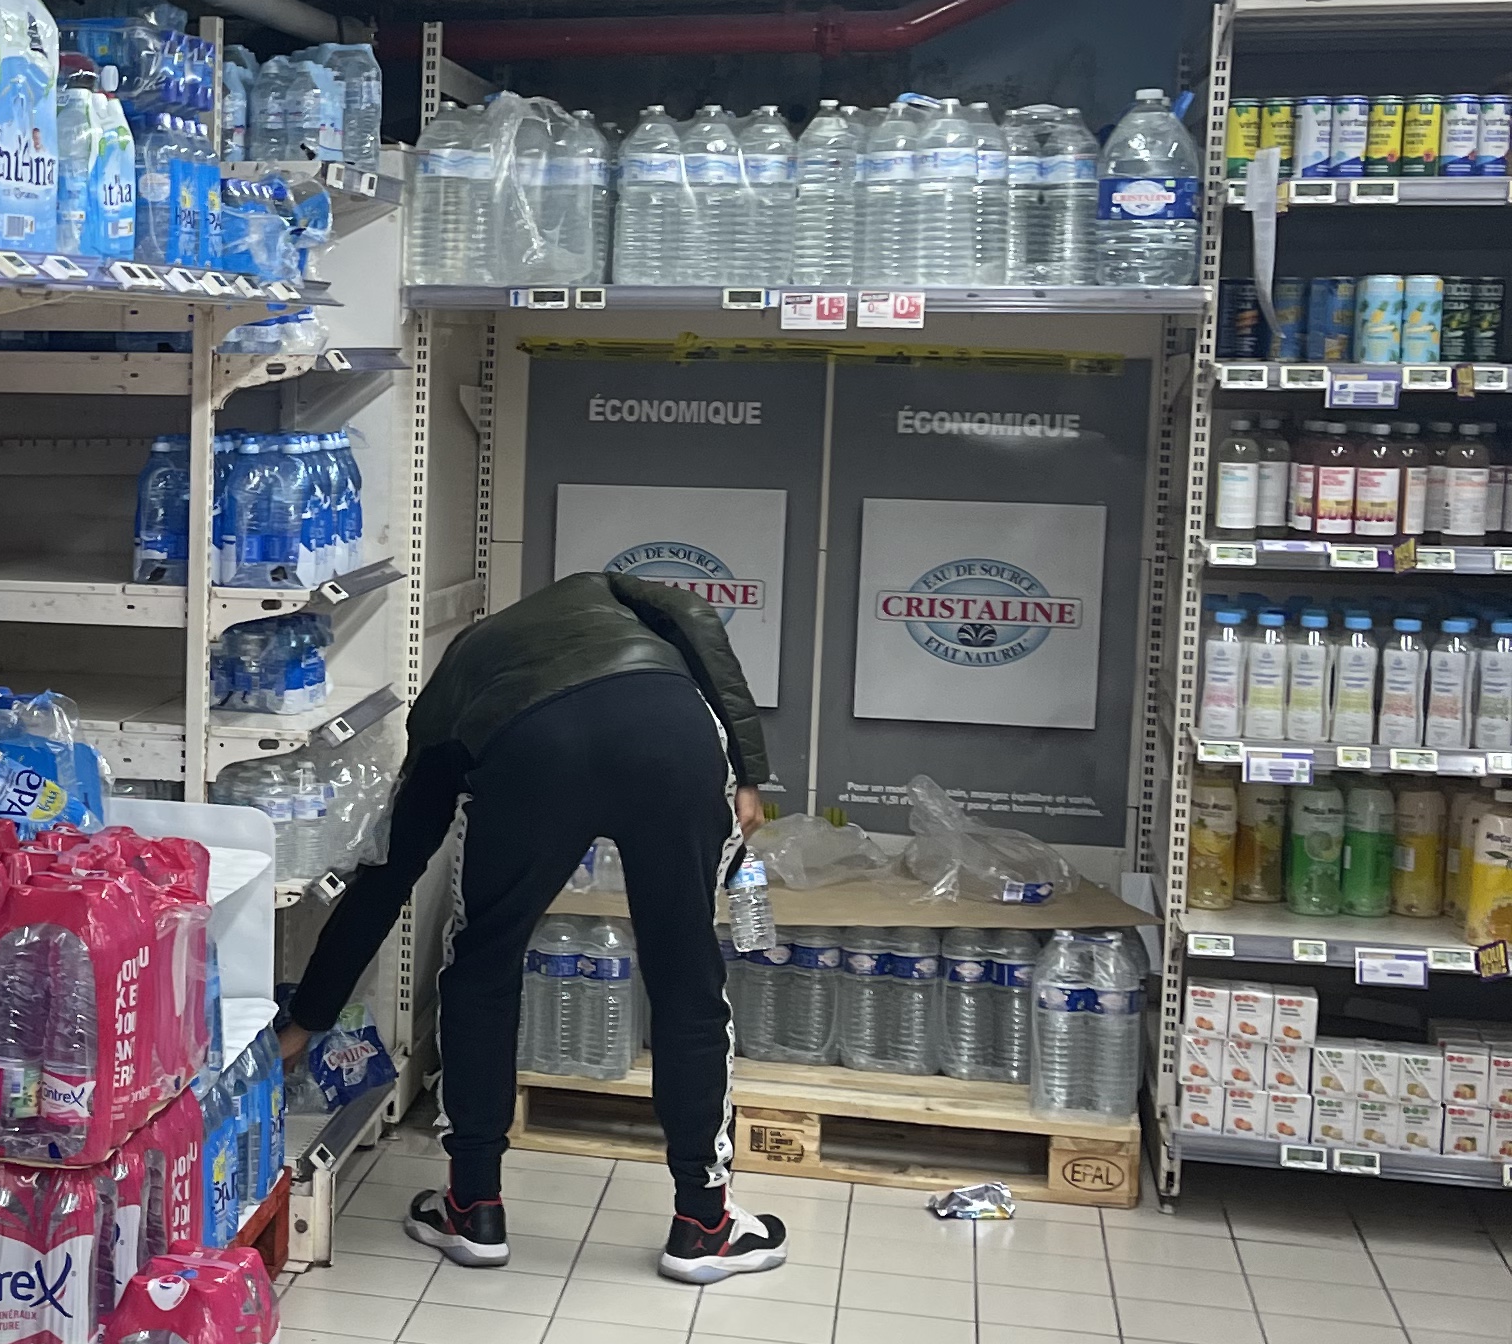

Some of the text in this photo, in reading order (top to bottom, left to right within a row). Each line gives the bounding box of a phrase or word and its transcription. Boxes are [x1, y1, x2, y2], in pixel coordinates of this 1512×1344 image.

[589, 394, 762, 425] ÉCONOMIQUE
[897, 405, 1081, 438] ÉCONOMIQUE
[613, 546, 723, 577] EAU DE SOURCE
[922, 563, 1037, 595] EAU DE SOURCE
[882, 595, 1076, 624] CRISTALINE
[924, 635, 1027, 664] ETAT NATUREL
[1070, 1162, 1115, 1186] EPAL
